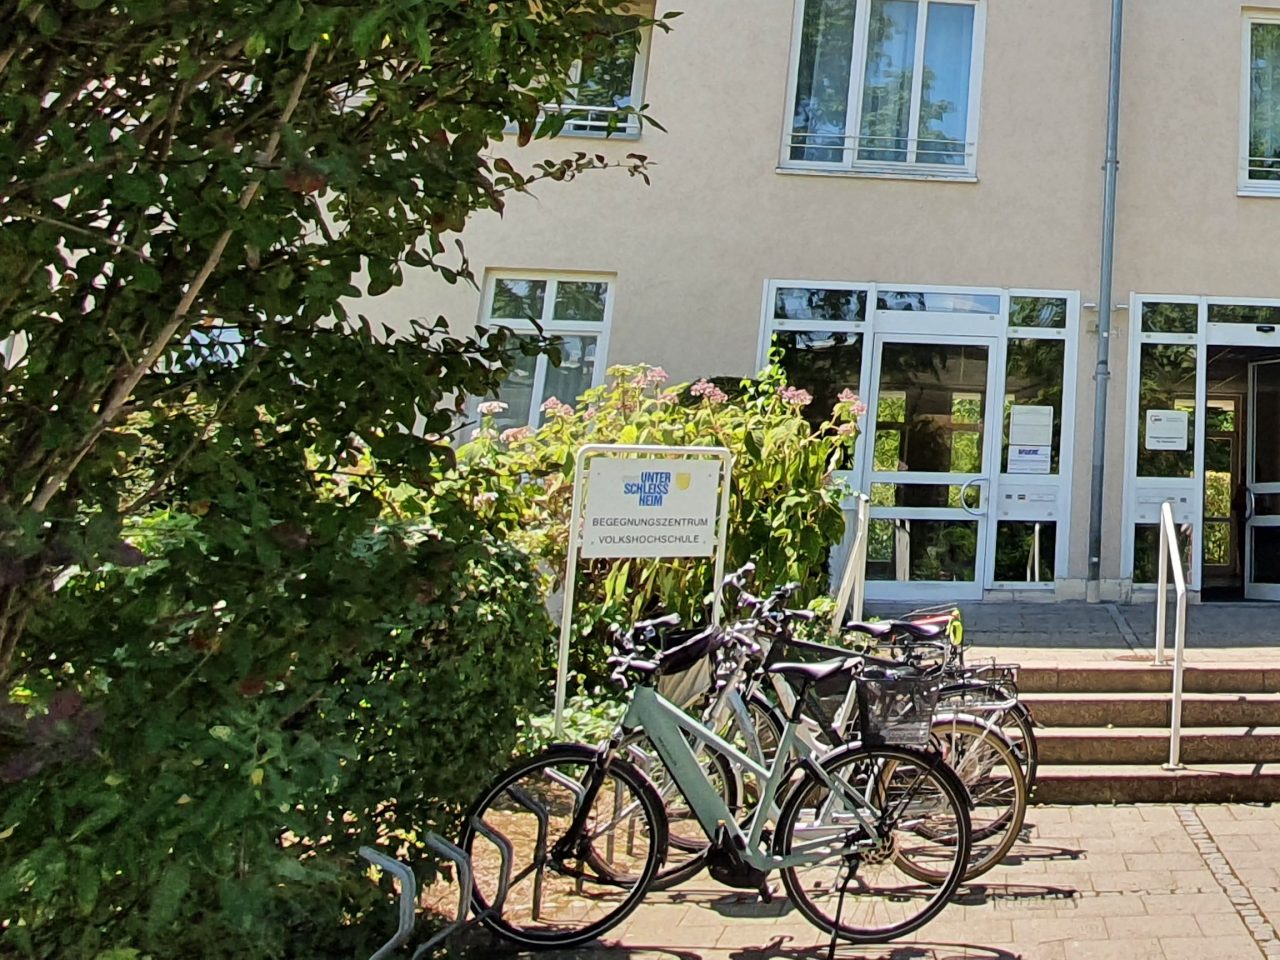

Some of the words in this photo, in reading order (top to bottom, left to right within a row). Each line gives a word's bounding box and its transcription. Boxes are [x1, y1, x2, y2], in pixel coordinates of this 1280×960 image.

[641, 471, 671, 483] UNTER
[624, 483, 669, 495] SCHLEISS
[638, 494, 663, 507] HEIM
[592, 517, 708, 527] BEGEGNUNGSZENTRUM
[598, 534, 700, 544] VOLKSHOCHSCHULE
